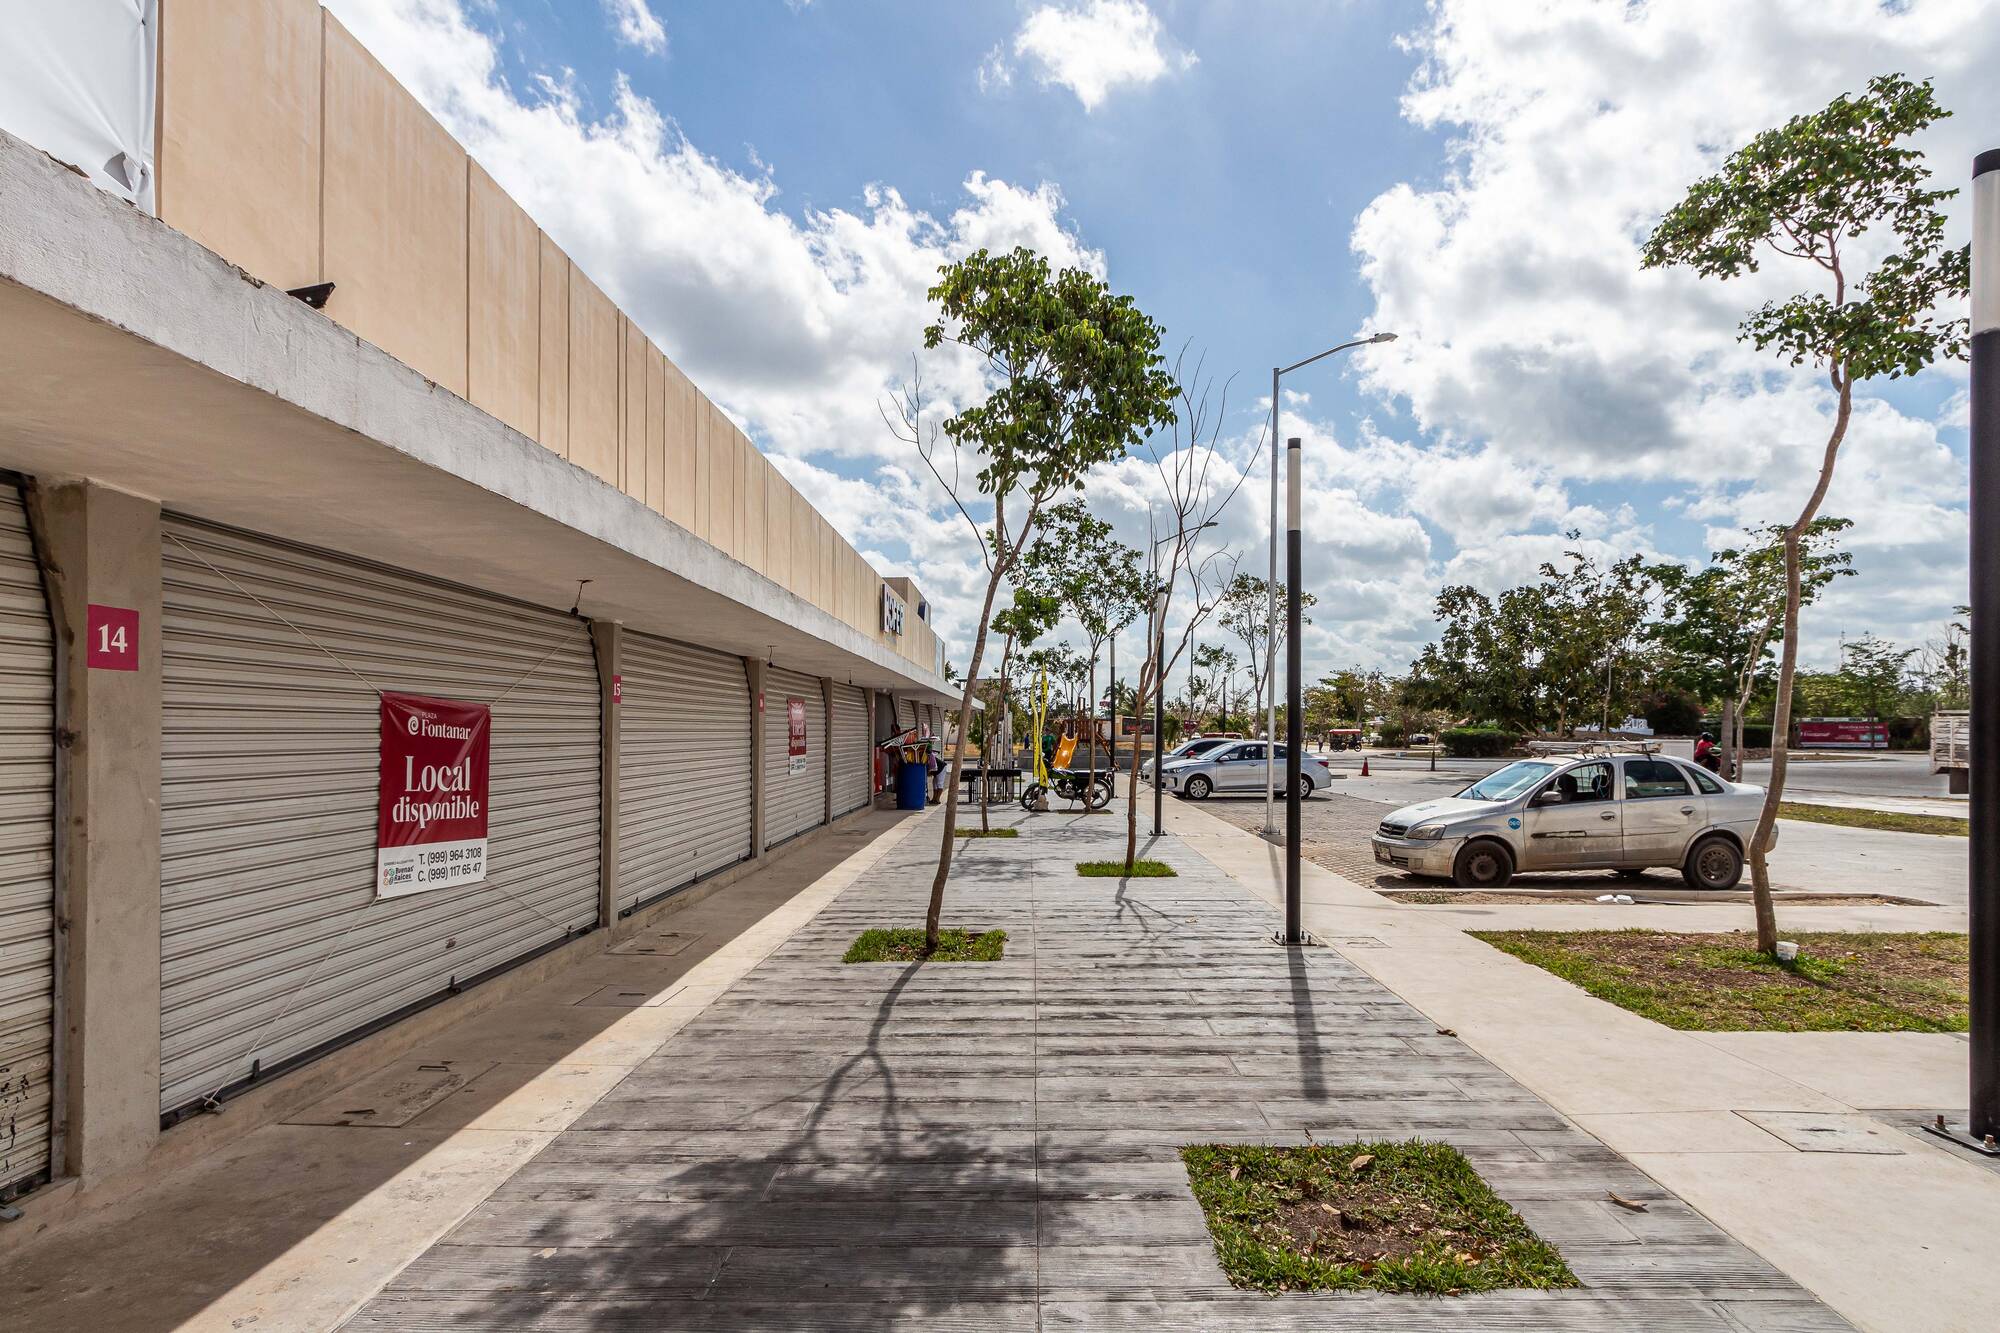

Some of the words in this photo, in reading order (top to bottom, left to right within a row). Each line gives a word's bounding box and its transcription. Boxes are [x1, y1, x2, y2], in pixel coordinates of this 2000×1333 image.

[98, 623, 128, 653] 14
[613, 683, 621, 696] 15
[421, 711, 438, 719] PLAZA
[421, 718, 471, 740] Fontanar
[404, 755, 471, 792] Local
[392, 795, 480, 829] disponible
[418, 853, 426, 865] T.
[427, 850, 448, 866] (999)
[449, 848, 464, 861] 964
[465, 846, 482, 859] 3108
[417, 870, 426, 882] C.
[428, 866, 448, 883] (999)
[450, 865, 460, 877] 117
[462, 864, 471, 875] 65
[473, 862, 482, 873] 47
